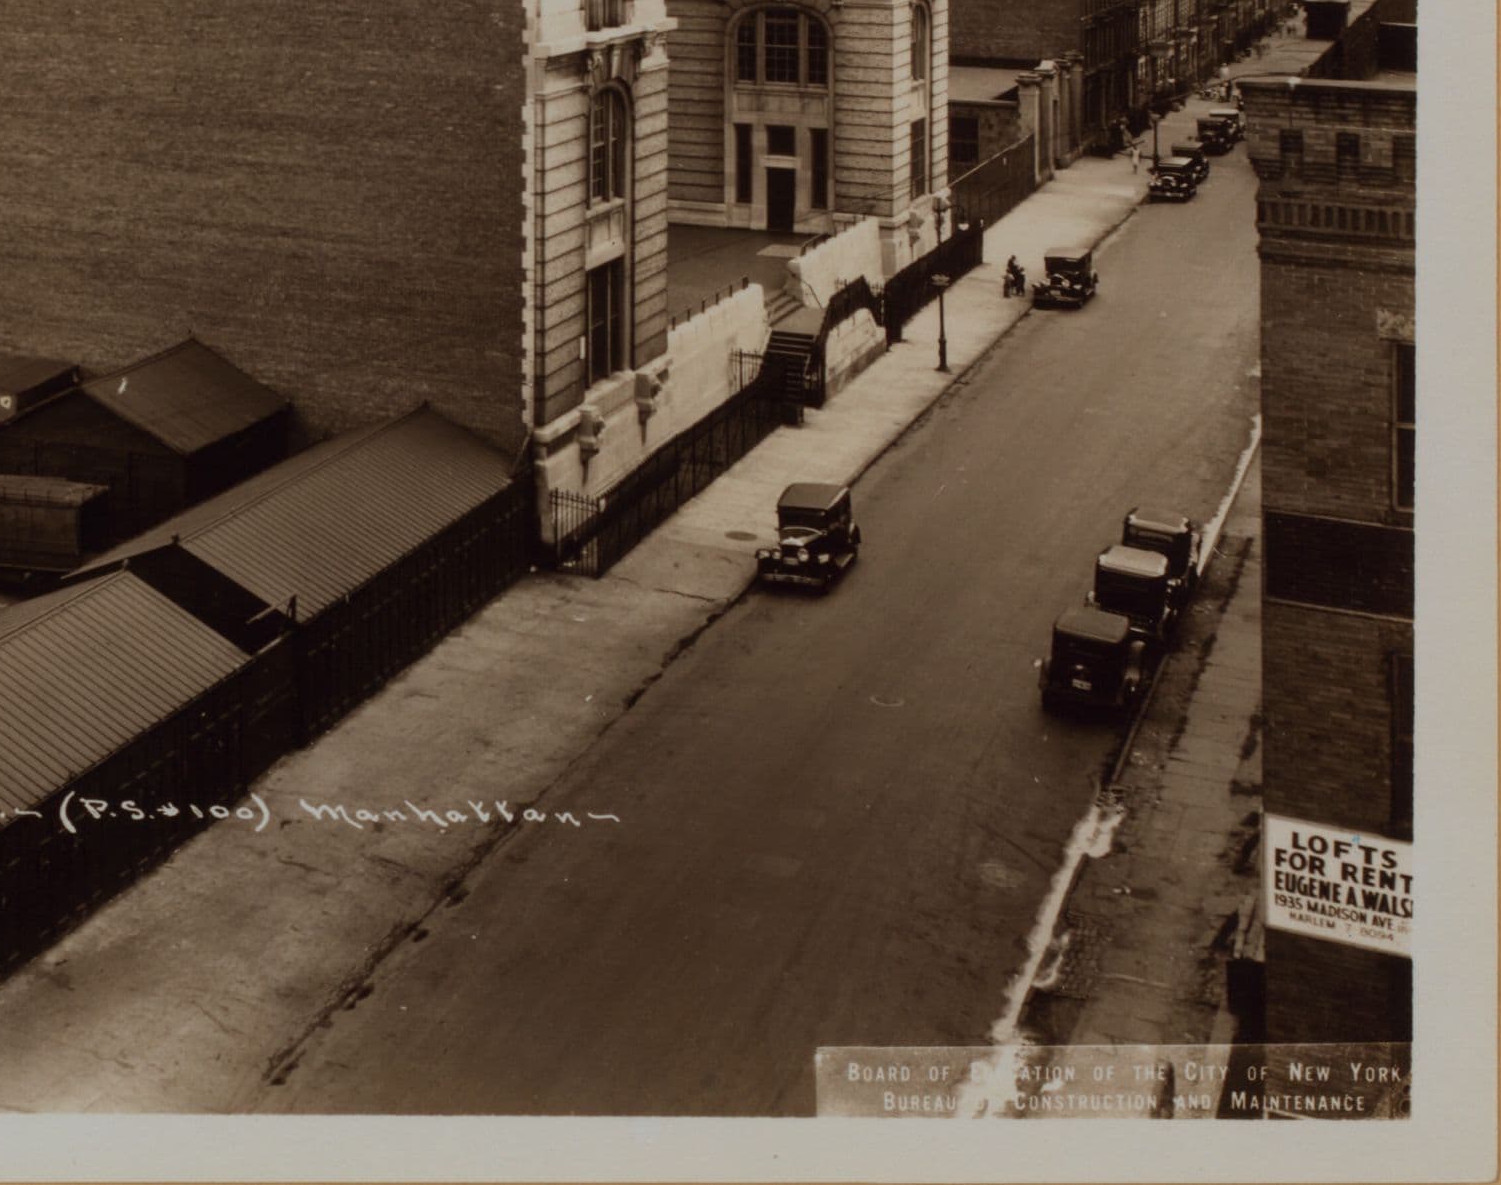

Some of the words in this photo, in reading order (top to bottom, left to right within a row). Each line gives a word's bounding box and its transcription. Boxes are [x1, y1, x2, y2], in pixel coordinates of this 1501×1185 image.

[1292, 831, 1398, 869] LOFTS
[1275, 847, 1326, 877] FOR
[1341, 862, 1413, 895] RENT
[1274, 870, 1342, 904] EUGENE
[1346, 886, 1359, 908] A
[1361, 889, 1414, 919] WALS
[1274, 893, 1303, 910] 1935
[1306, 900, 1367, 924] MADISON
[1372, 914, 1394, 931] AVE
[1289, 912, 1336, 929] HARLEM
